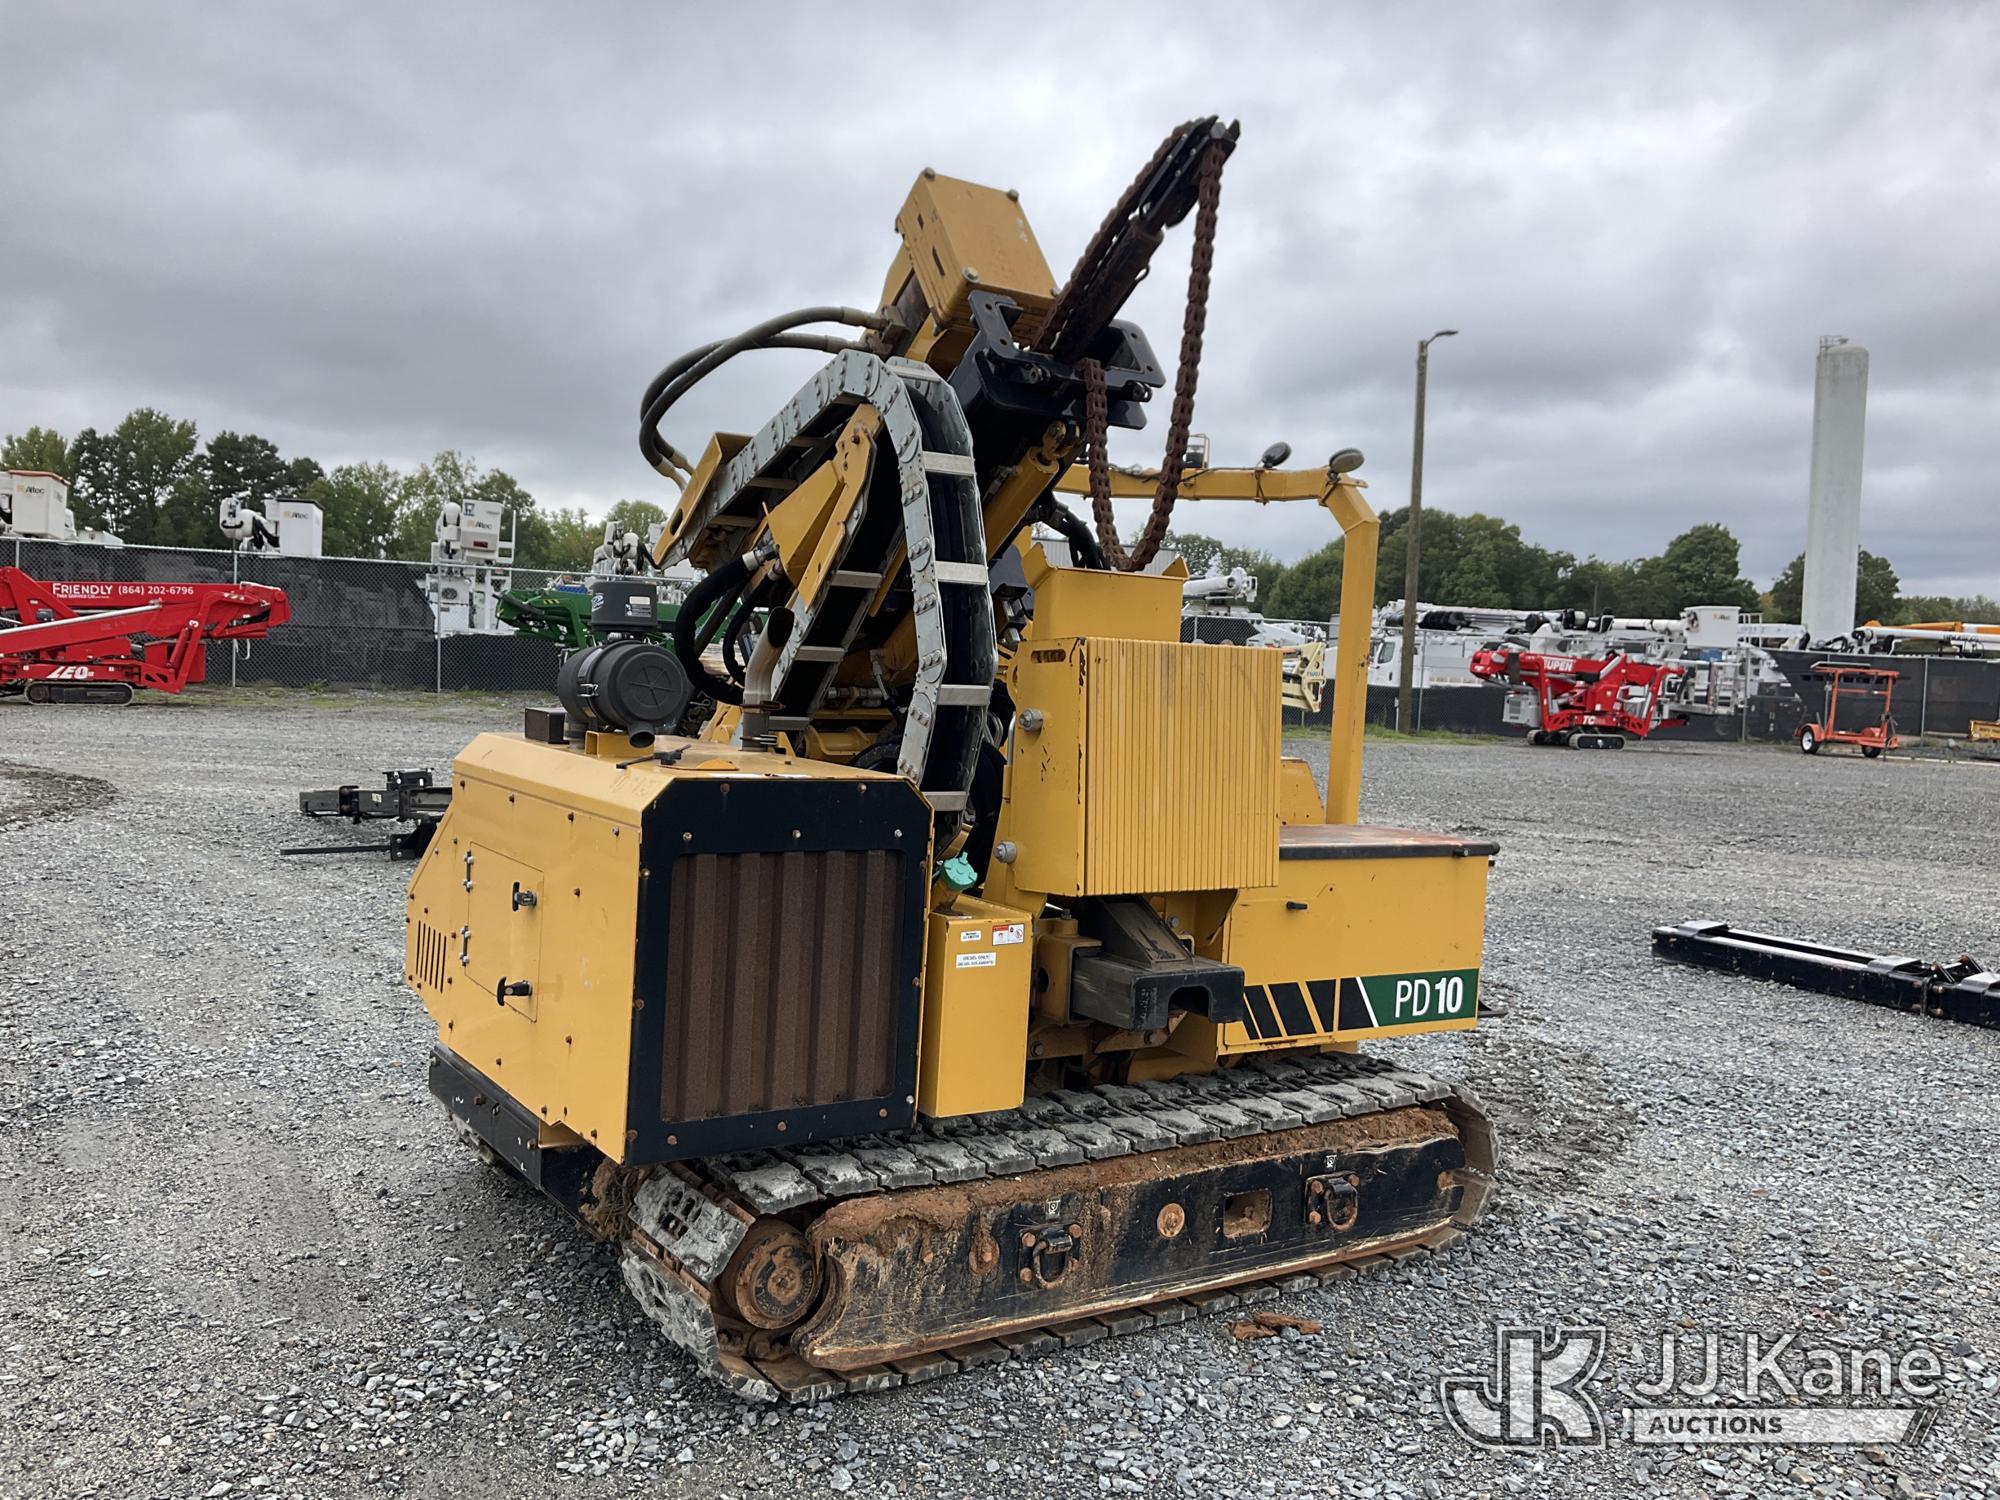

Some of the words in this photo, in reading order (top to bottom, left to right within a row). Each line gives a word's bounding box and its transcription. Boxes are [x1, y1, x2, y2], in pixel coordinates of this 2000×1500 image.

[52, 583, 113, 595] FRIENDLY
[118, 585, 144, 595] (864)
[147, 585, 194, 595] 202-6796
[46, 666, 89, 679] LEO
[1395, 979, 1431, 1018] PD
[1434, 976, 1464, 1014] 10
